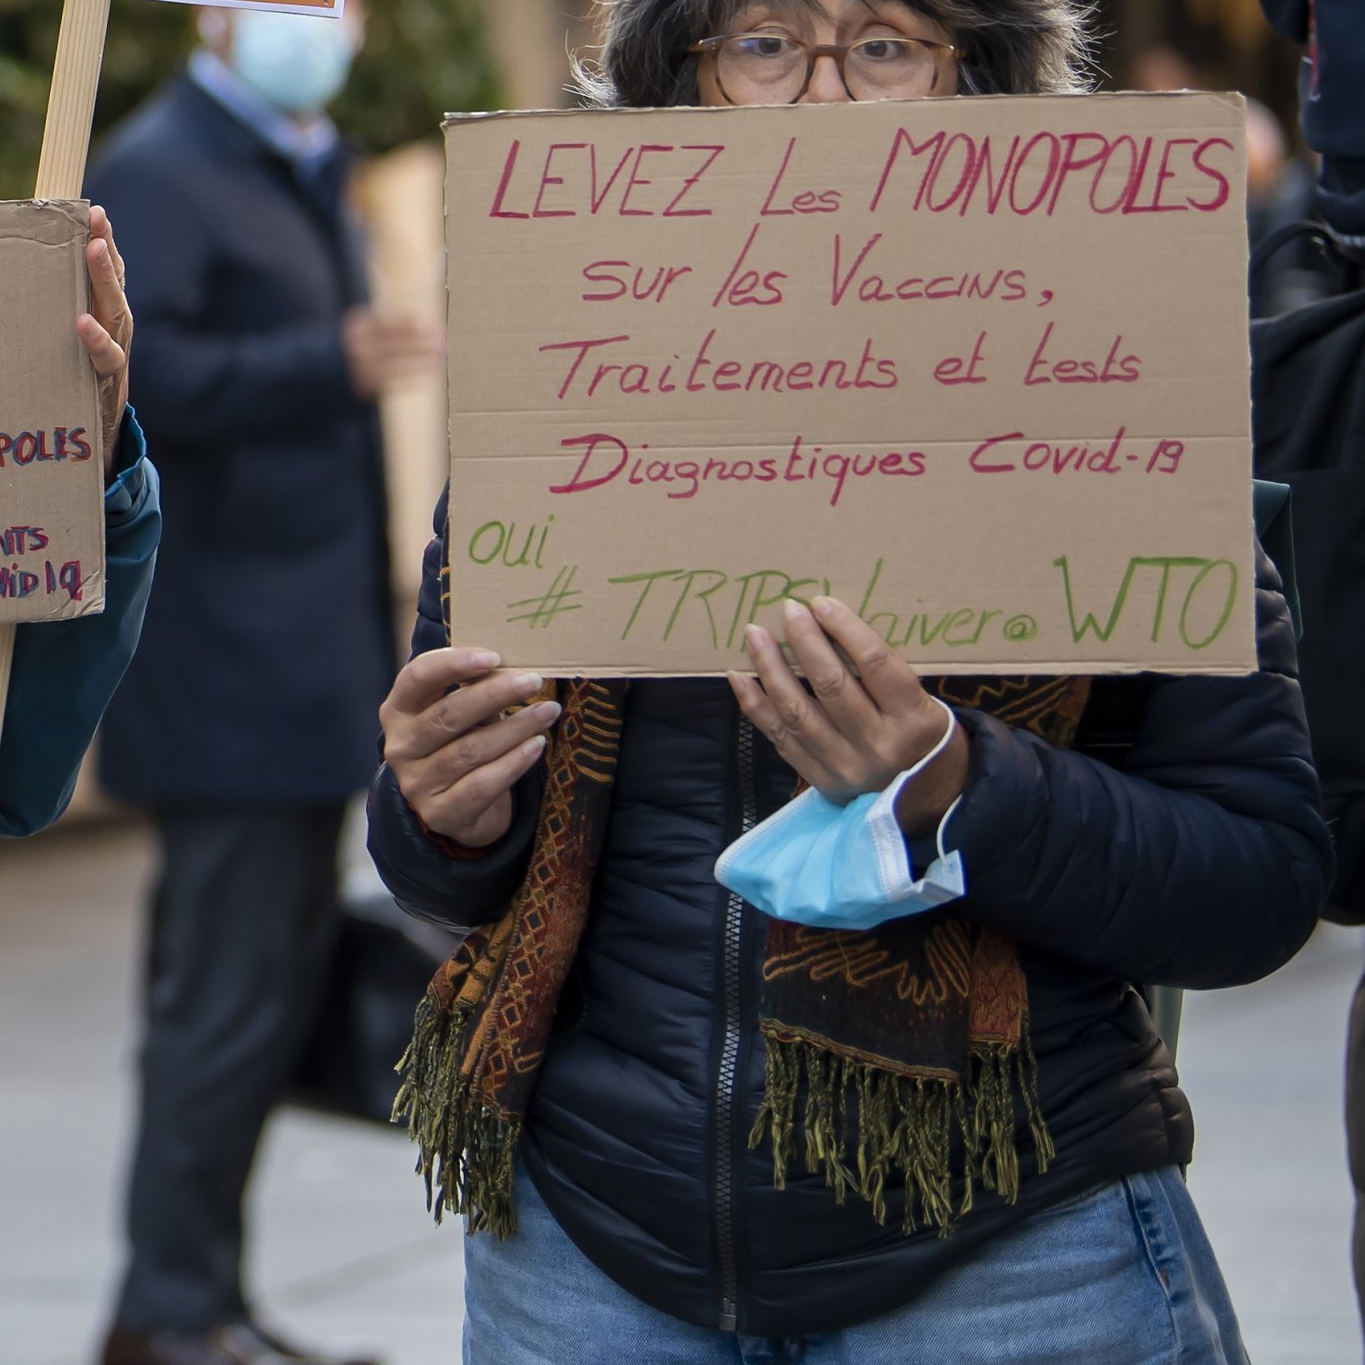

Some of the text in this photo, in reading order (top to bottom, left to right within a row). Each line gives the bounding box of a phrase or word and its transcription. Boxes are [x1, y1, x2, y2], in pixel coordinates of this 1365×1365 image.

[489, 139, 725, 220] LEVEZ
[869, 126, 1235, 218] MONOPOLES
[713, 222, 788, 308] les
[538, 321, 1142, 400] Traitements et tests
[548, 427, 1185, 507] Diagnostiques Covid-19
[1052, 554, 1239, 650] WTO
